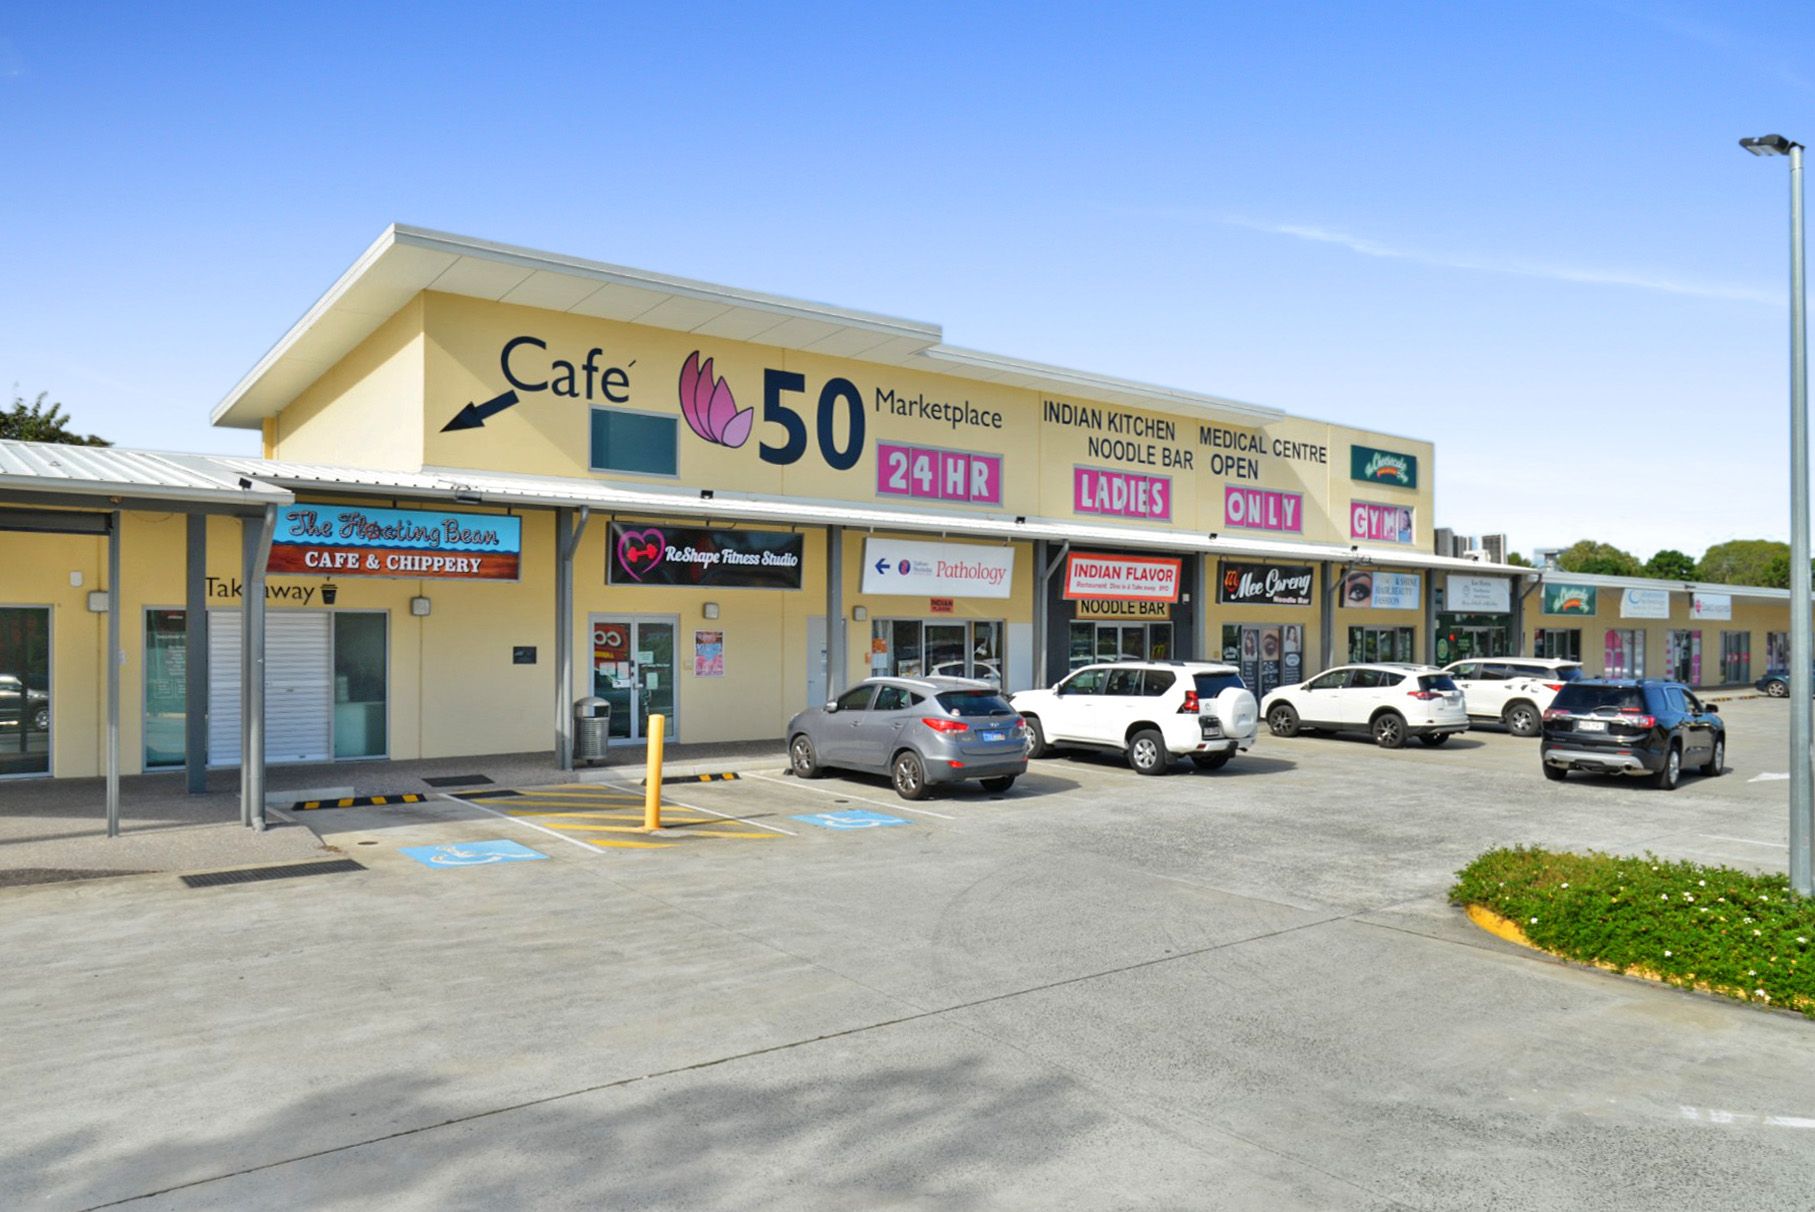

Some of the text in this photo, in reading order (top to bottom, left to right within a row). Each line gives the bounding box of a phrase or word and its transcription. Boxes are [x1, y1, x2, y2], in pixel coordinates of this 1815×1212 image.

[759, 368, 866, 471] 50
[876, 387, 1003, 430] Marketplace
[1044, 400, 1176, 441] INDIAN KITCHEN
[1089, 436, 1194, 470] NOODLE BAR
[1200, 426, 1327, 464] MEDICAL CENTRE
[1211, 454, 1259, 480] OPEN
[1081, 474, 1164, 514] LADIES
[1227, 492, 1296, 527] ONLY
[287, 510, 500, 547] The Floating Bean
[1353, 507, 1395, 537] GYM
[304, 551, 482, 573] CAFE & CHIPPERY
[665, 546, 798, 569] ReShape Fitness Studio
[936, 560, 1006, 584] Pathology
[1074, 563, 1173, 582] INDIAN FLAVOR
[206, 577, 315, 606] Takway
[1230, 568, 1311, 600] Mee Goreng
[1081, 600, 1165, 615] NOODLE BAR
